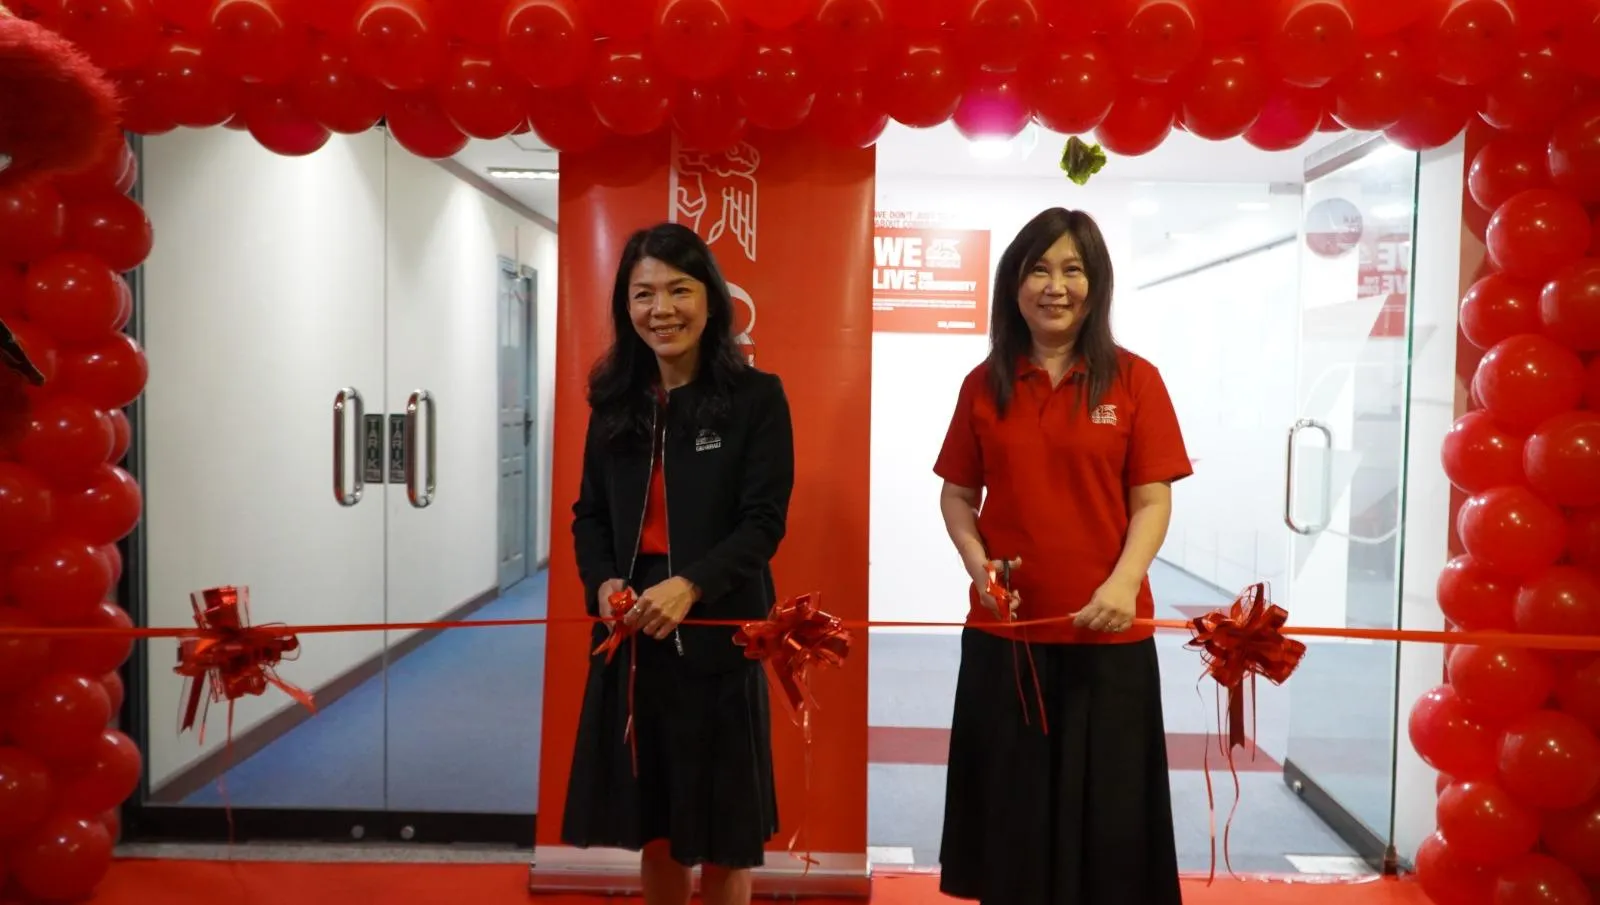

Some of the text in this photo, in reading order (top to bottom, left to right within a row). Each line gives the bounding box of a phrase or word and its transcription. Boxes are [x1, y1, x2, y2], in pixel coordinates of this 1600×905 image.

[873, 237, 922, 267] WE
[872, 269, 917, 290] LIVE
[366, 418, 379, 469] TARIK
[391, 419, 403, 469] TARIK
